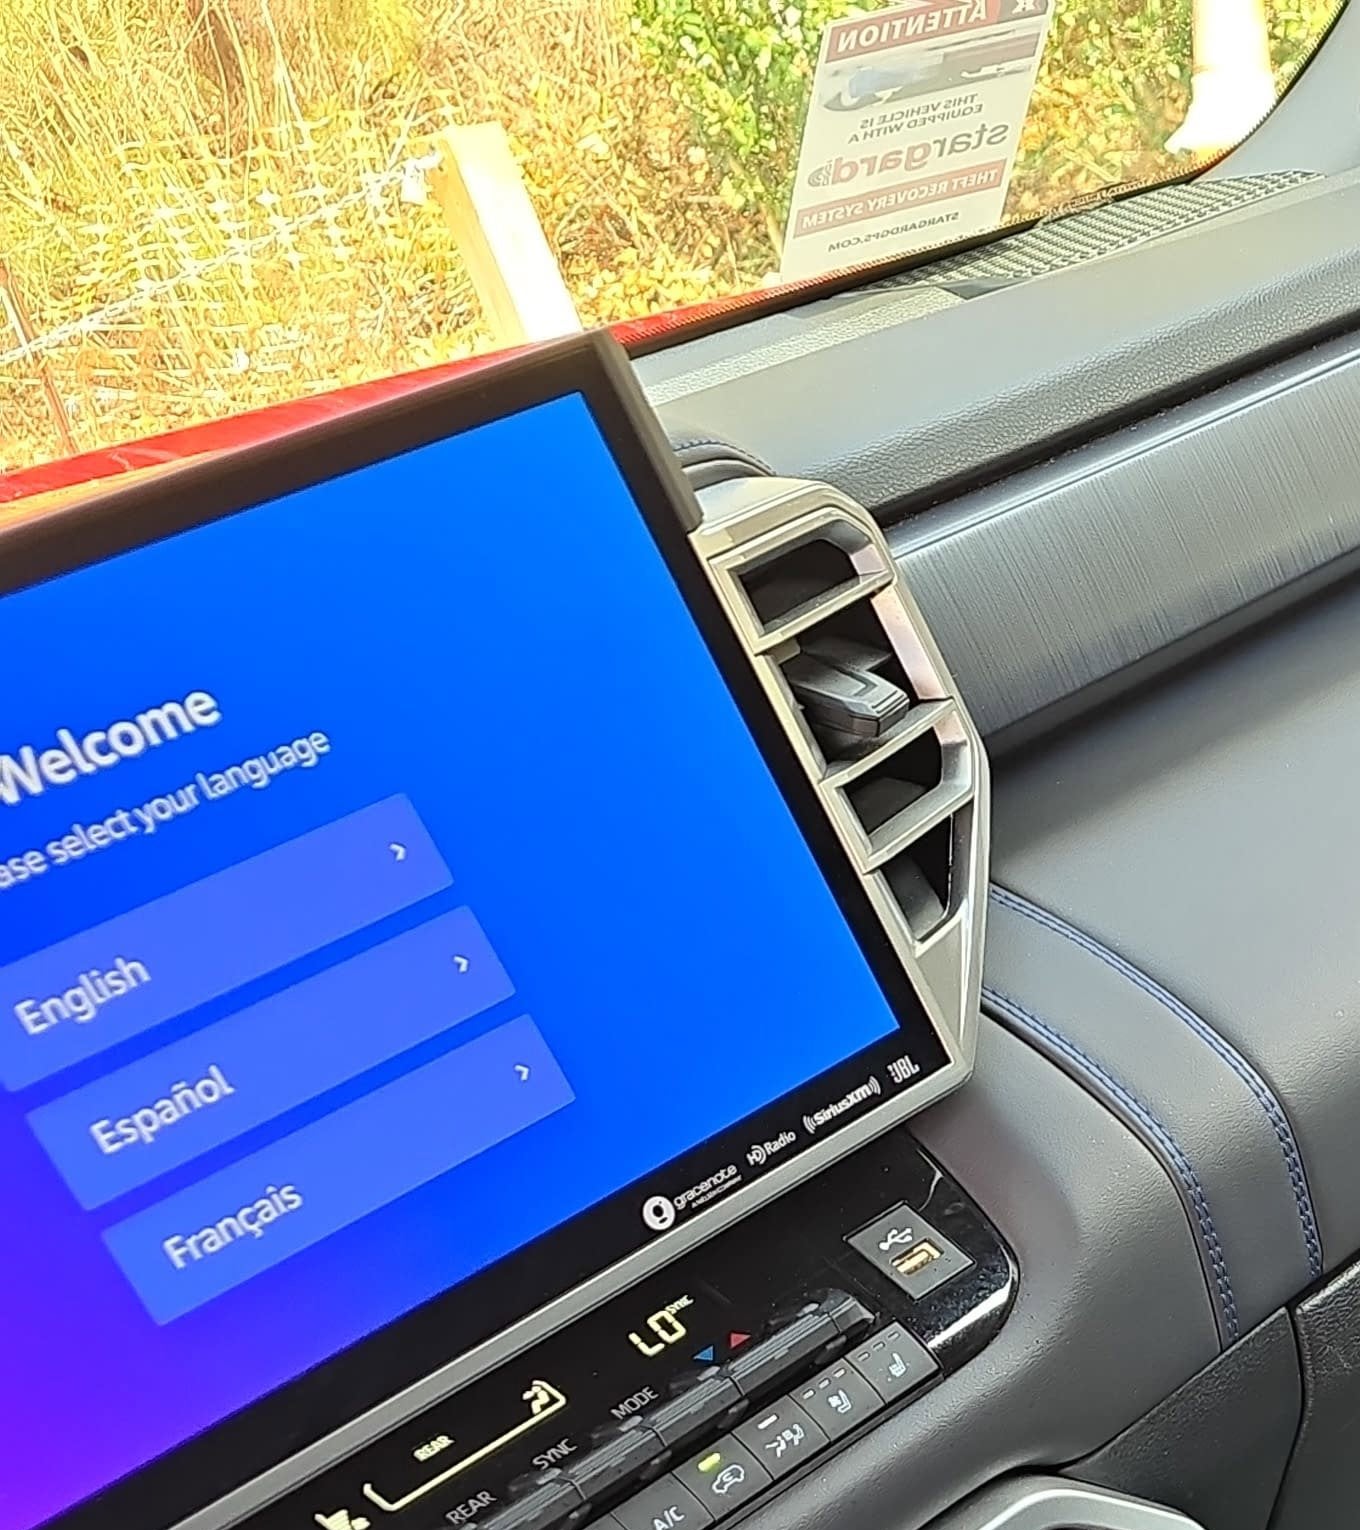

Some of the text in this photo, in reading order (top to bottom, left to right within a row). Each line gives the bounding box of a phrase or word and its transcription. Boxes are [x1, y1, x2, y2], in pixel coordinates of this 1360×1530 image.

[0, 690, 222, 806] Welcome
[0, 731, 332, 890] ase select your language
[13, 956, 152, 1037] English
[886, 1054, 920, 1084] JBL
[89, 1063, 236, 1155] Español
[764, 1130, 797, 1157] Radio
[673, 1164, 738, 1211] gracenote
[162, 1183, 304, 1270] Français
[610, 1385, 659, 1421] MODE
[412, 1434, 456, 1462] REAR
[531, 1437, 579, 1471] SYNC
[445, 1489, 498, 1525] REAR
